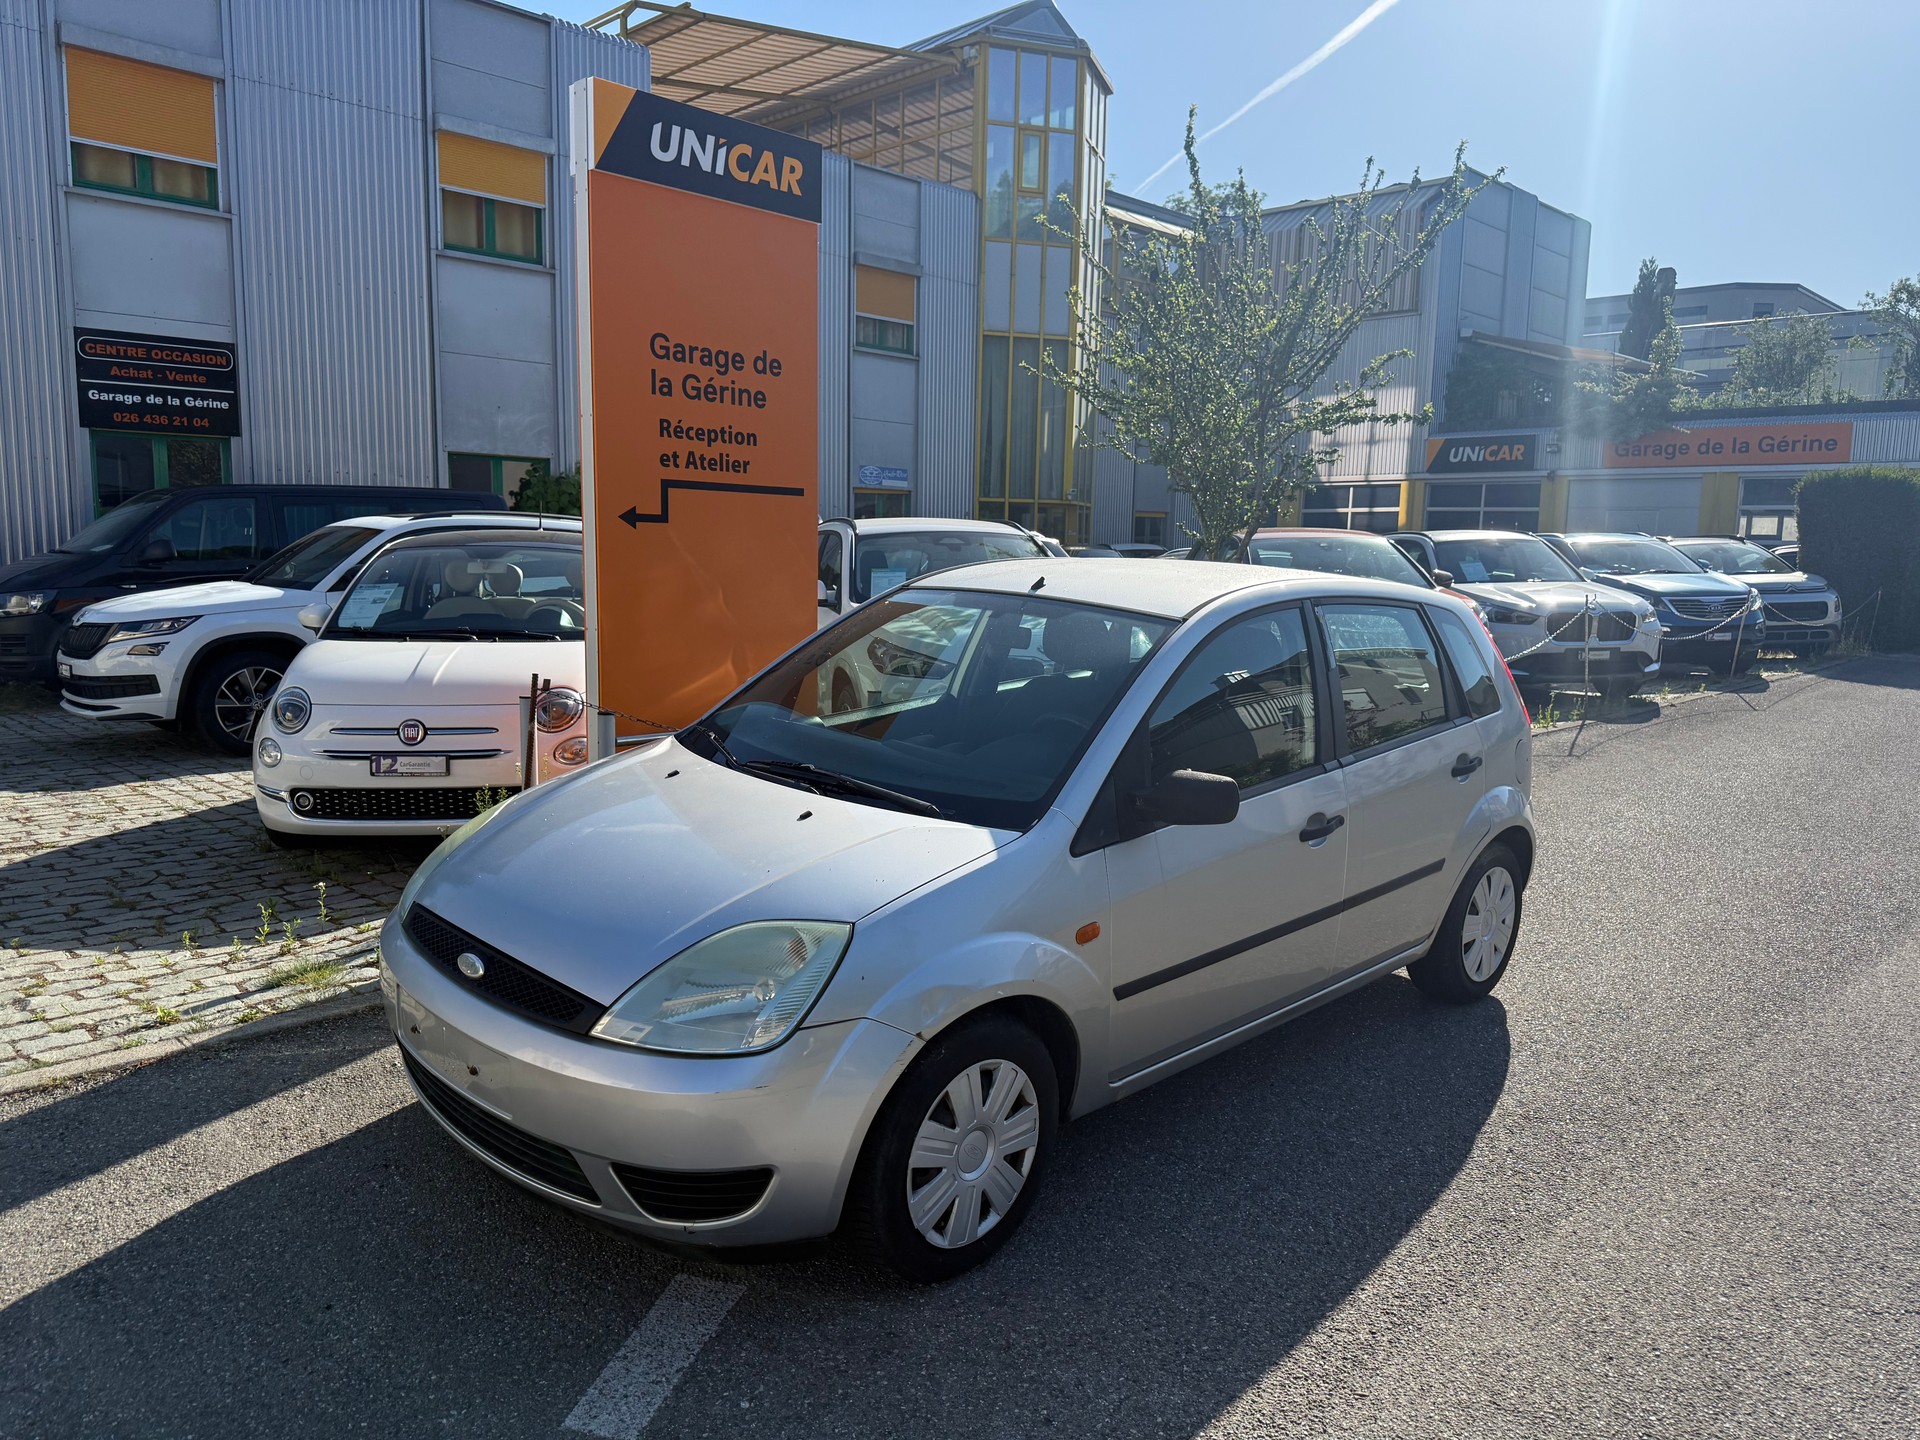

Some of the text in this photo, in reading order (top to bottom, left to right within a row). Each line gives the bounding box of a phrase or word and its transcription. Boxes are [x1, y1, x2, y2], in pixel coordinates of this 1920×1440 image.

[85, 342, 228, 366] CENTRE OCCASION
[650, 332, 782, 377] Garage de
[110, 365, 153, 379] Achat
[166, 371, 207, 384] Vente
[88, 389, 230, 410] Garage de la Gérine
[651, 368, 767, 409] la Gérine
[113, 412, 209, 428] 026 436 21 04
[659, 418, 757, 447] Réception
[1615, 435, 1838, 460] Garage de la Gérine
[659, 450, 750, 474] et Atelier
[404, 727, 419, 738] FIAT
